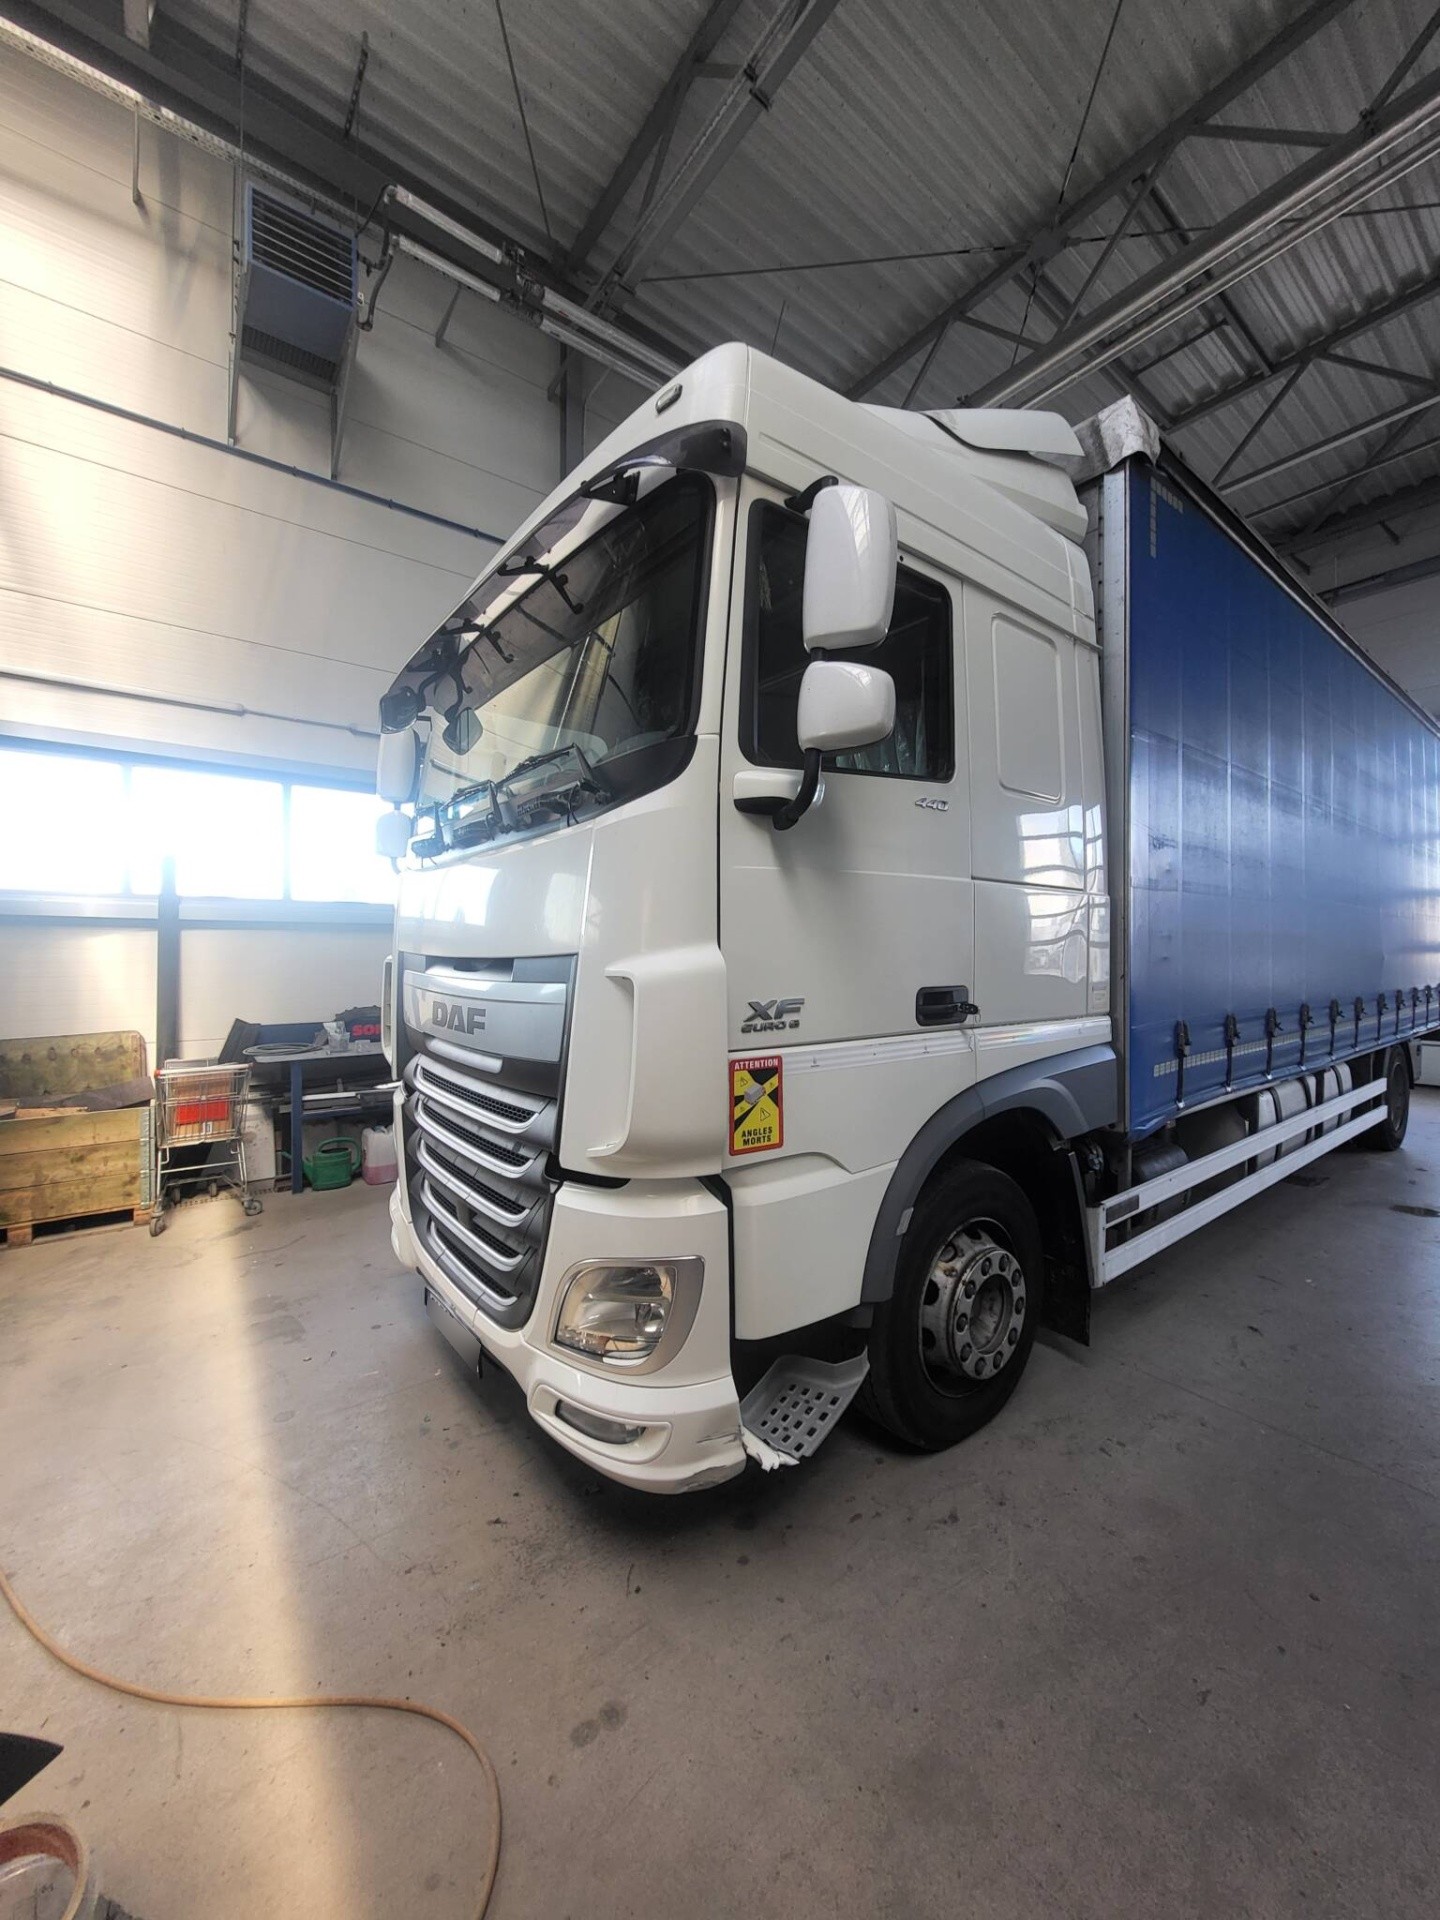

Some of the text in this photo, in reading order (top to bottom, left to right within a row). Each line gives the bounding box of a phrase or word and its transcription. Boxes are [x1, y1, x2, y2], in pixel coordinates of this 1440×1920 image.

[915, 797, 949, 811] 440
[743, 998, 805, 1023] XF
[432, 1001, 487, 1035] DAF
[734, 1058, 779, 1071] ATTENTION
[741, 1126, 773, 1138] ANGLES
[742, 1135, 772, 1146] MORTS
